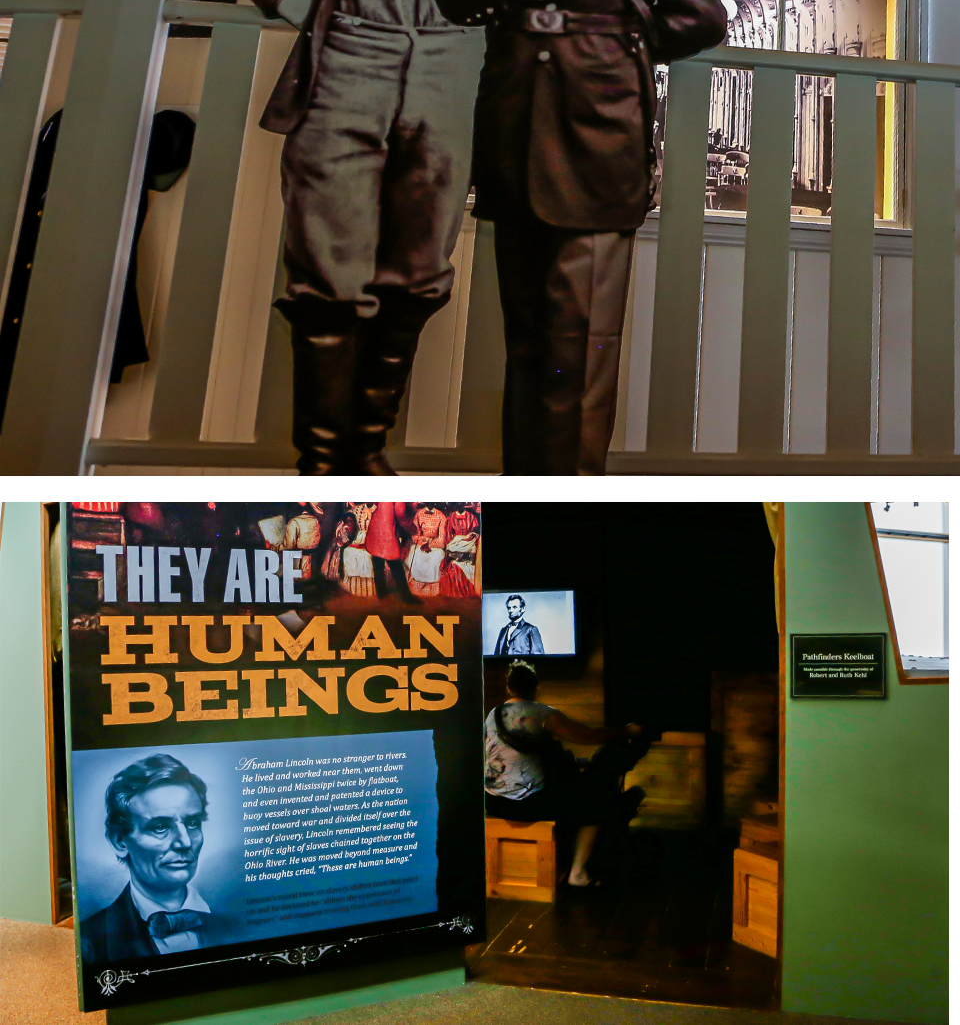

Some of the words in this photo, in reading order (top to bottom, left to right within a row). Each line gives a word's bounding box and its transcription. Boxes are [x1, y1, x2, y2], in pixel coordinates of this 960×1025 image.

[96, 545, 211, 603] THEY
[224, 548, 303, 603] ARE
[100, 615, 459, 665] HUMAN
[102, 663, 459, 725] BEINGS
[235, 757, 283, 771] Abraham
[286, 758, 313, 768] Lincoln
[316, 757, 331, 765] was
[344, 755, 375, 764] stranger
[385, 751, 407, 760] rivers.
[242, 775, 253, 783] He
[255, 773, 273, 782] lived
[276, 771, 290, 781] and
[293, 769, 320, 779] worked
[342, 767, 362, 775] them,
[364, 765, 382, 773] went
[384, 764, 403, 772] down
[243, 788, 255, 796] the
[258, 786, 275, 794] Ohio
[278, 784, 292, 792] and
[295, 780, 335, 791] Mississippi
[337, 779, 356, 787] twice
[358, 778, 366, 786] by
[368, 775, 398, 787] flatboat,
